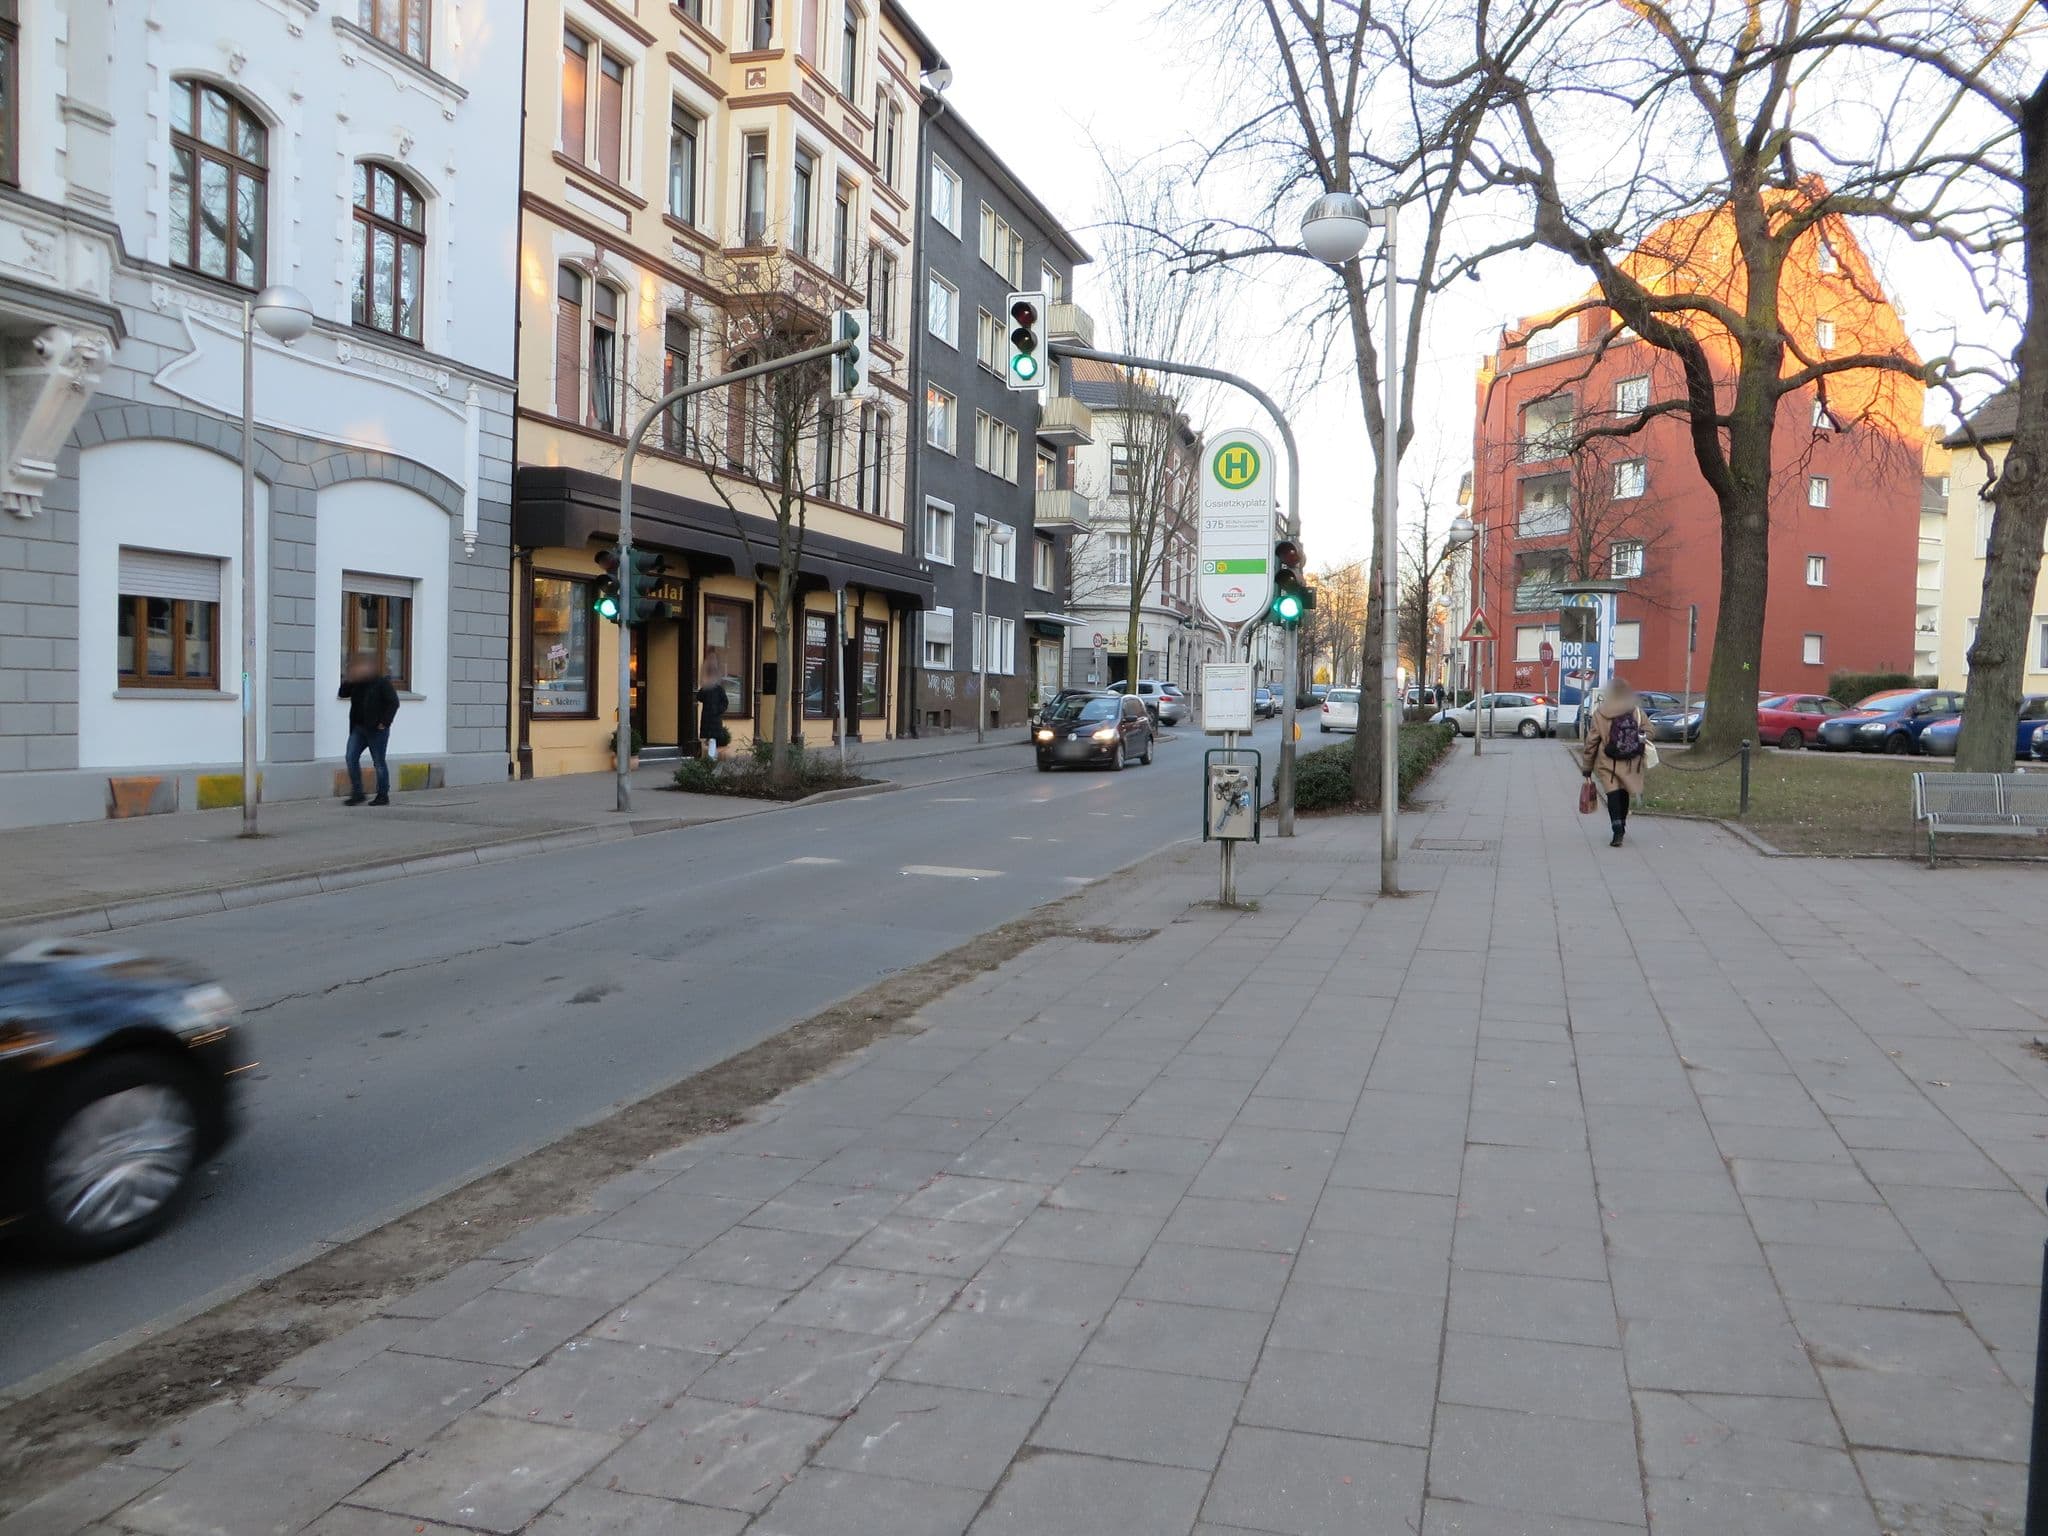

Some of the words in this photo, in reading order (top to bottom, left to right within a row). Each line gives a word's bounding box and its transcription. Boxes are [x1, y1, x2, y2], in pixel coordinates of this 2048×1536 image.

[1225, 452, 1248, 479] H
[1204, 498, 1267, 509] Ossietzkyplatz
[1205, 520, 1224, 529] 375
[1541, 649, 1552, 660] STOP
[1562, 642, 1583, 656] FOR
